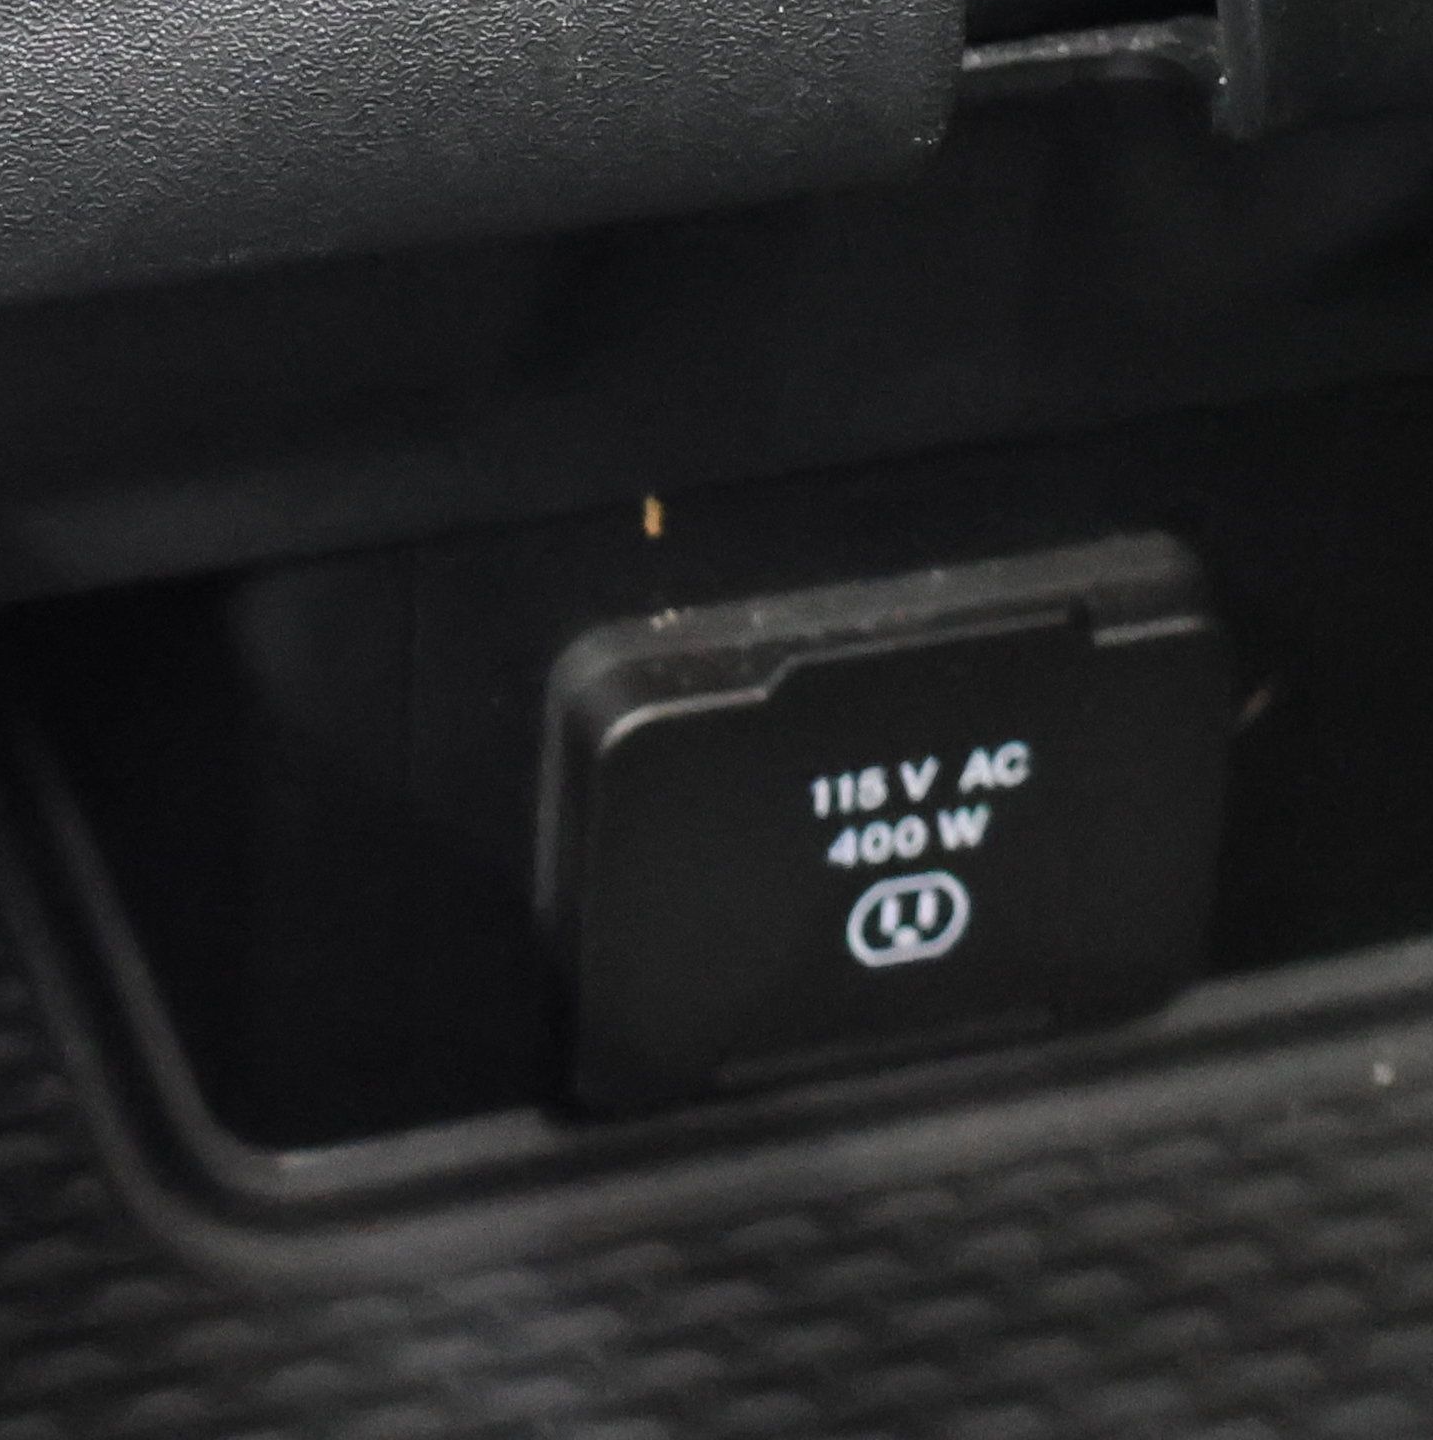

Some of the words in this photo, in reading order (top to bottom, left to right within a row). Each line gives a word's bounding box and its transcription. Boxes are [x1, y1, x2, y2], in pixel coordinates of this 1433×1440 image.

[812, 767, 887, 818] 115
[900, 757, 939, 801] V
[960, 741, 1030, 793] AC
[828, 815, 927, 867] 400
[938, 805, 991, 851] W
